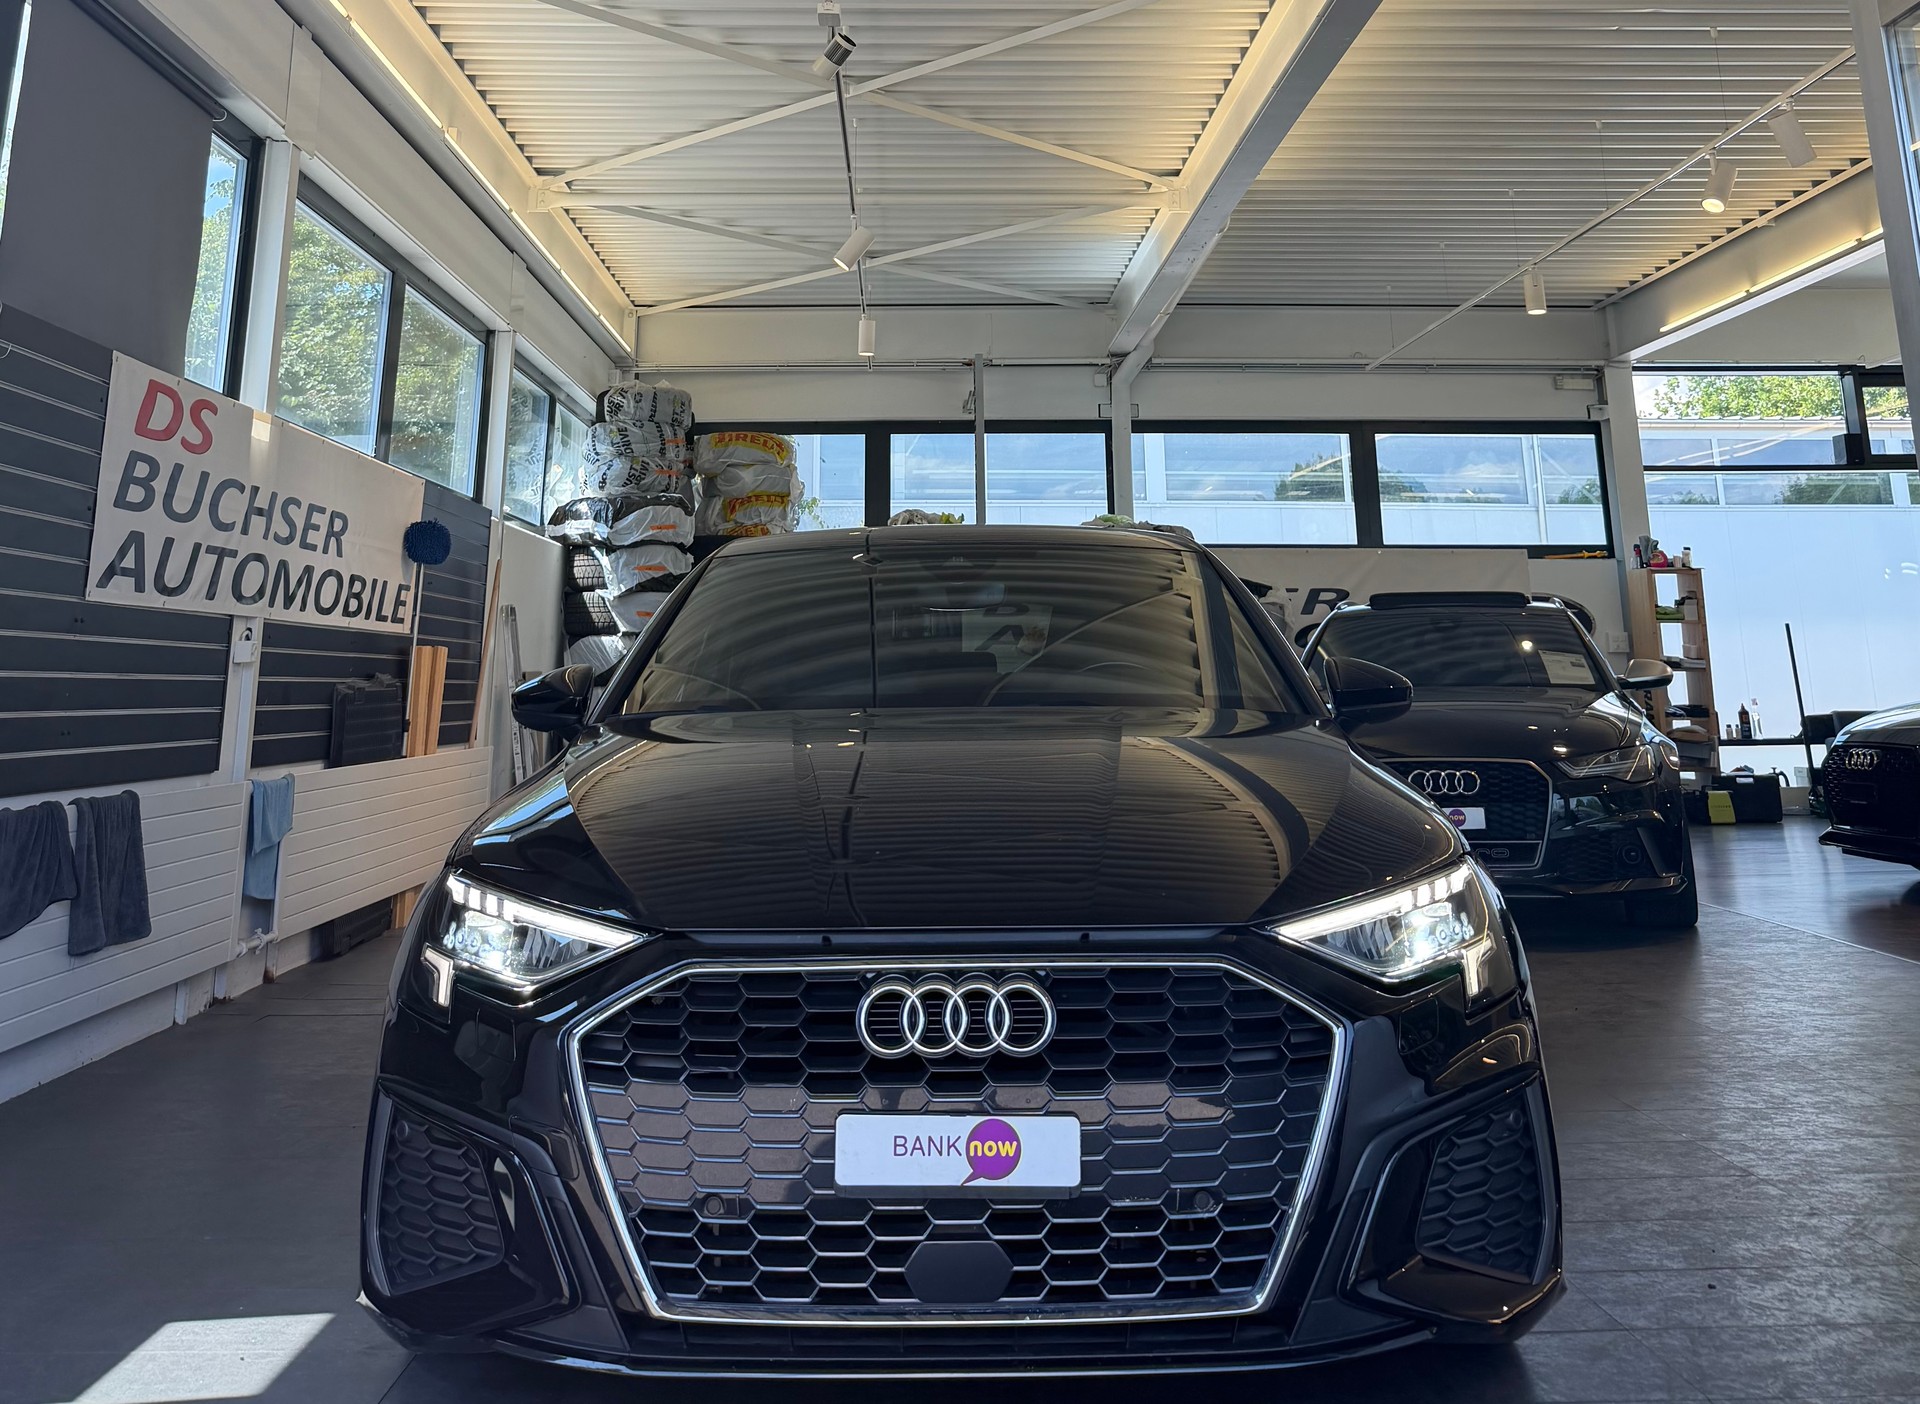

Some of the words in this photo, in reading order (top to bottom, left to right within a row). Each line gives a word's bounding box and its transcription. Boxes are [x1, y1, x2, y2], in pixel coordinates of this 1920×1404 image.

[134, 379, 219, 455] DS
[113, 450, 350, 558] BUCHSER
[96, 530, 412, 625] AUTOMOBILE
[893, 1135, 963, 1157] BANK
[969, 1140, 1018, 1157] now
